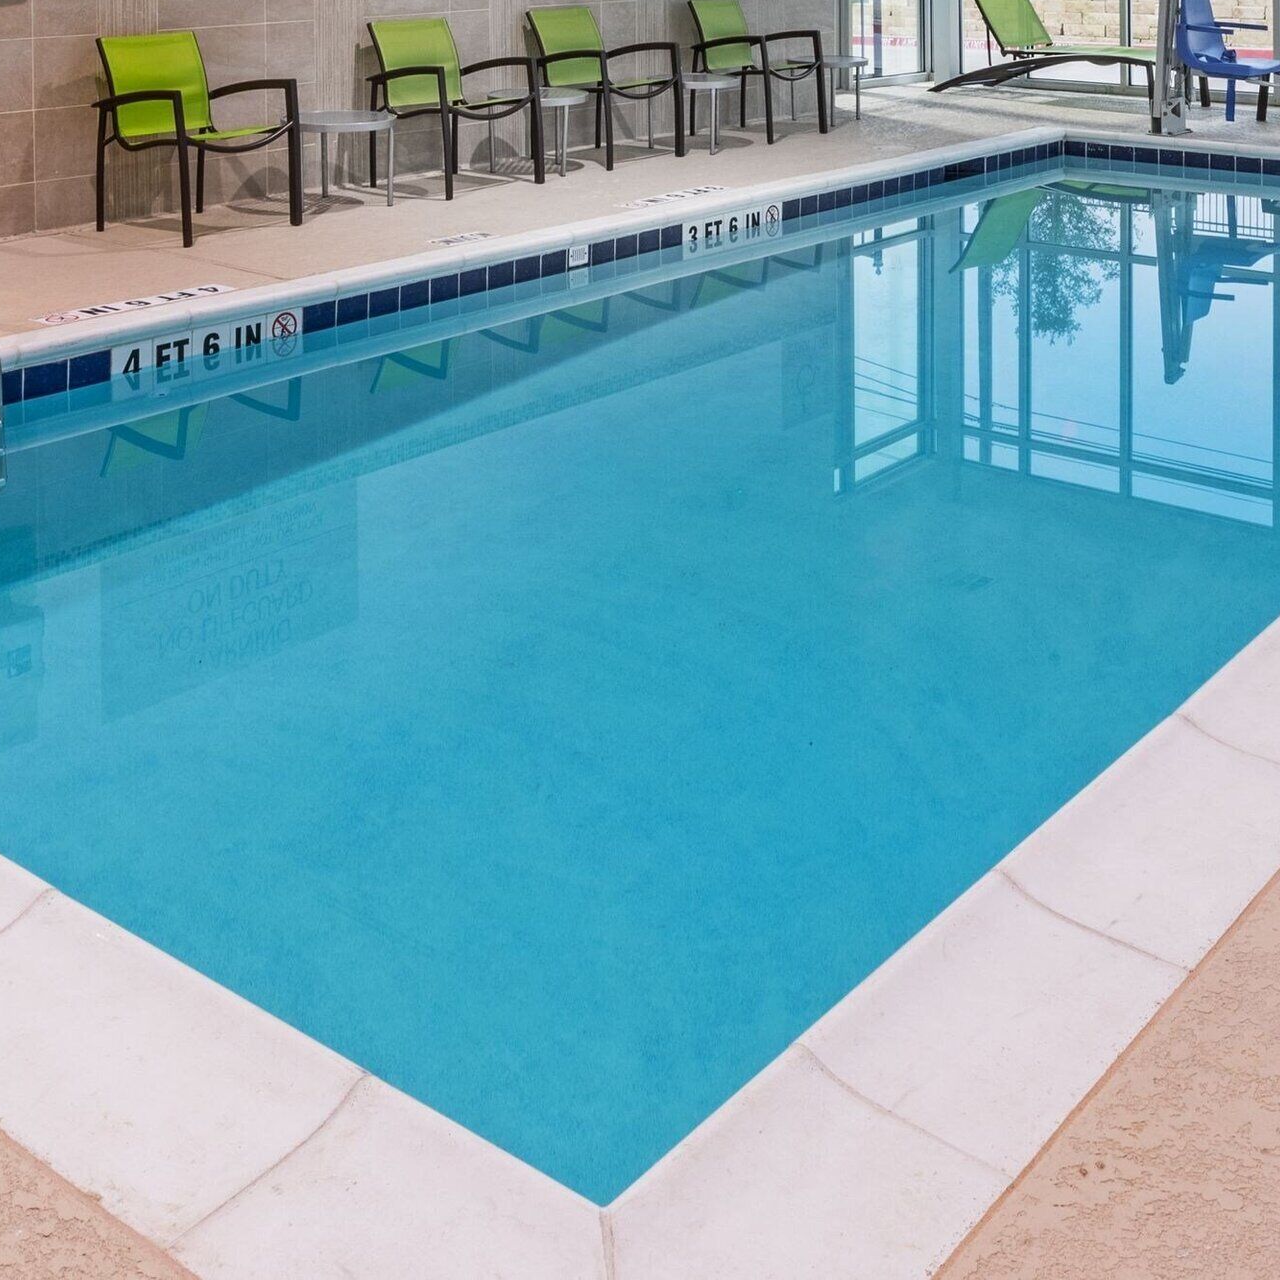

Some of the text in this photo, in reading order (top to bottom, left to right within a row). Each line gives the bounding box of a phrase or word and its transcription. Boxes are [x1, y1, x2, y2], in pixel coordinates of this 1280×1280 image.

[746, 211, 760, 229] IN
[203, 332, 220, 357] 6
[235, 322, 261, 350] IN
